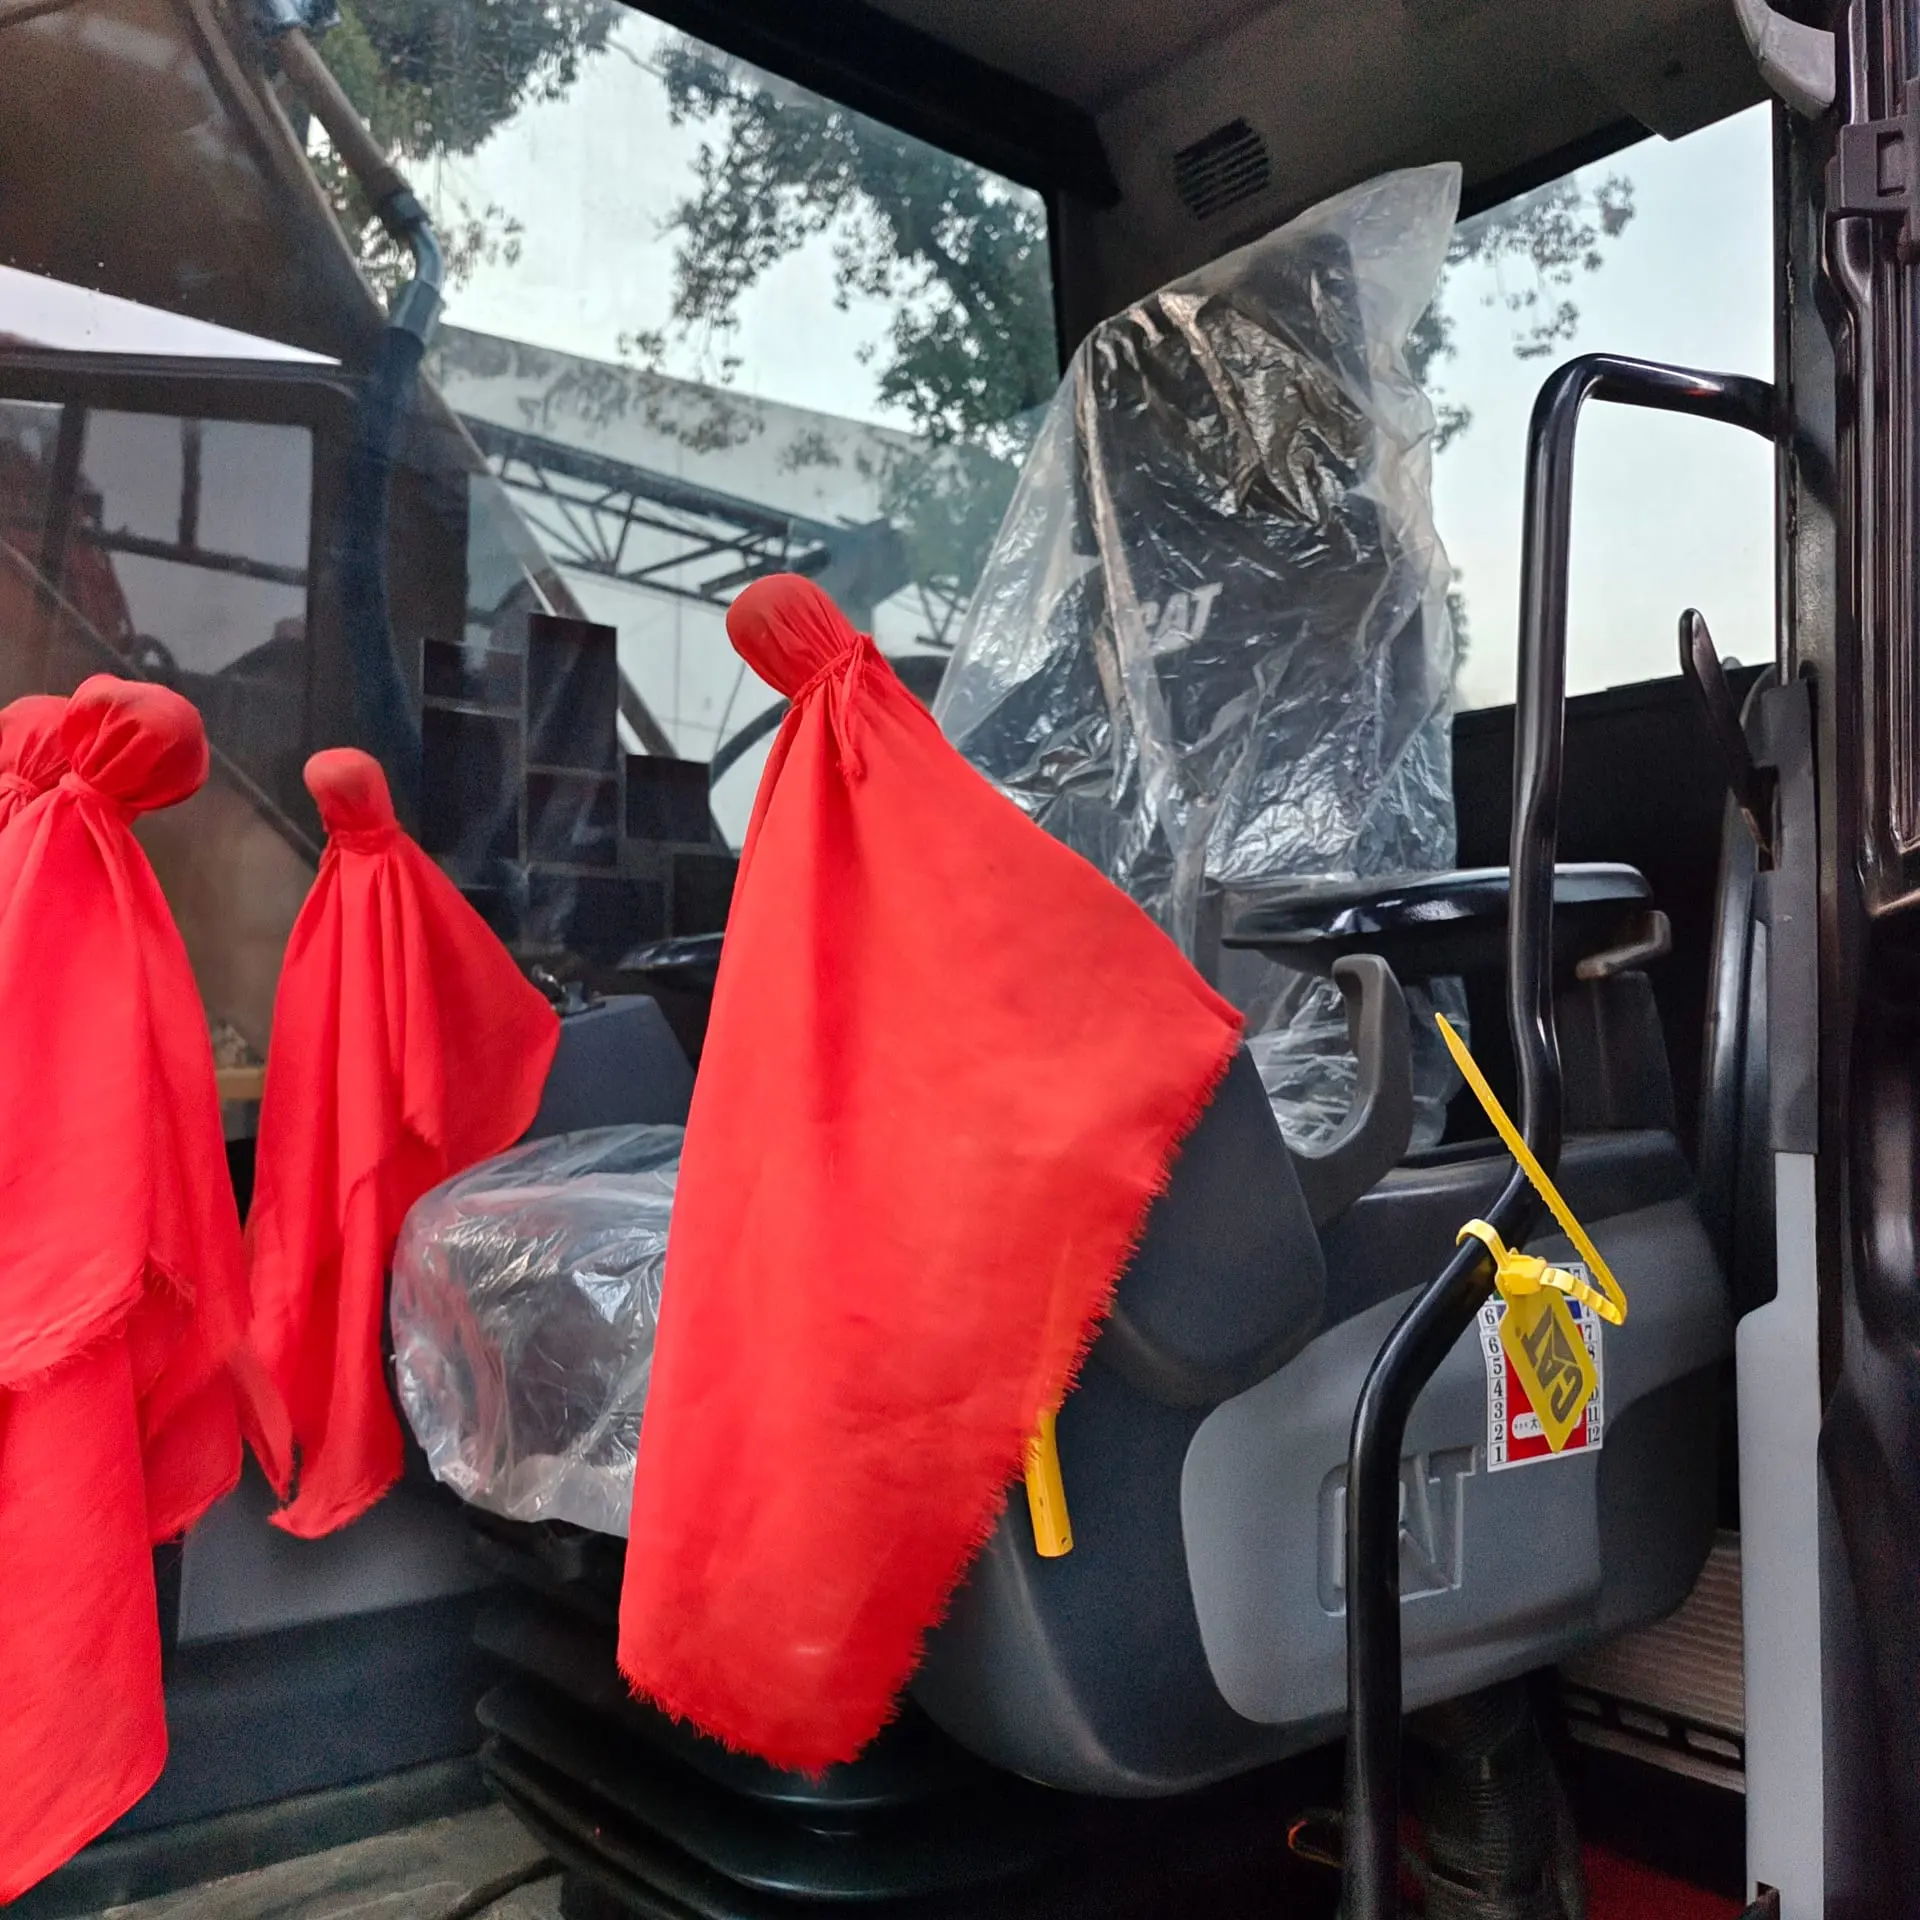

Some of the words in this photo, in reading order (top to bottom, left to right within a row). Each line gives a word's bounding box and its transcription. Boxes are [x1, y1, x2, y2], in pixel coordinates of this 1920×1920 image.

[1132, 582, 1224, 657] CAT
[1484, 1307, 1496, 1325] 6
[1584, 1323, 1593, 1341] 7
[1488, 1336, 1499, 1354] 6
[1492, 1357, 1503, 1375] 5
[1521, 1304, 1583, 1424] CAT
[1493, 1379, 1503, 1397] 4
[1494, 1401, 1503, 1419] 3
[1587, 1405, 1599, 1423] 11
[1494, 1423, 1504, 1441] 2
[1587, 1426, 1601, 1444] 12
[1495, 1446, 1503, 1462] 1
